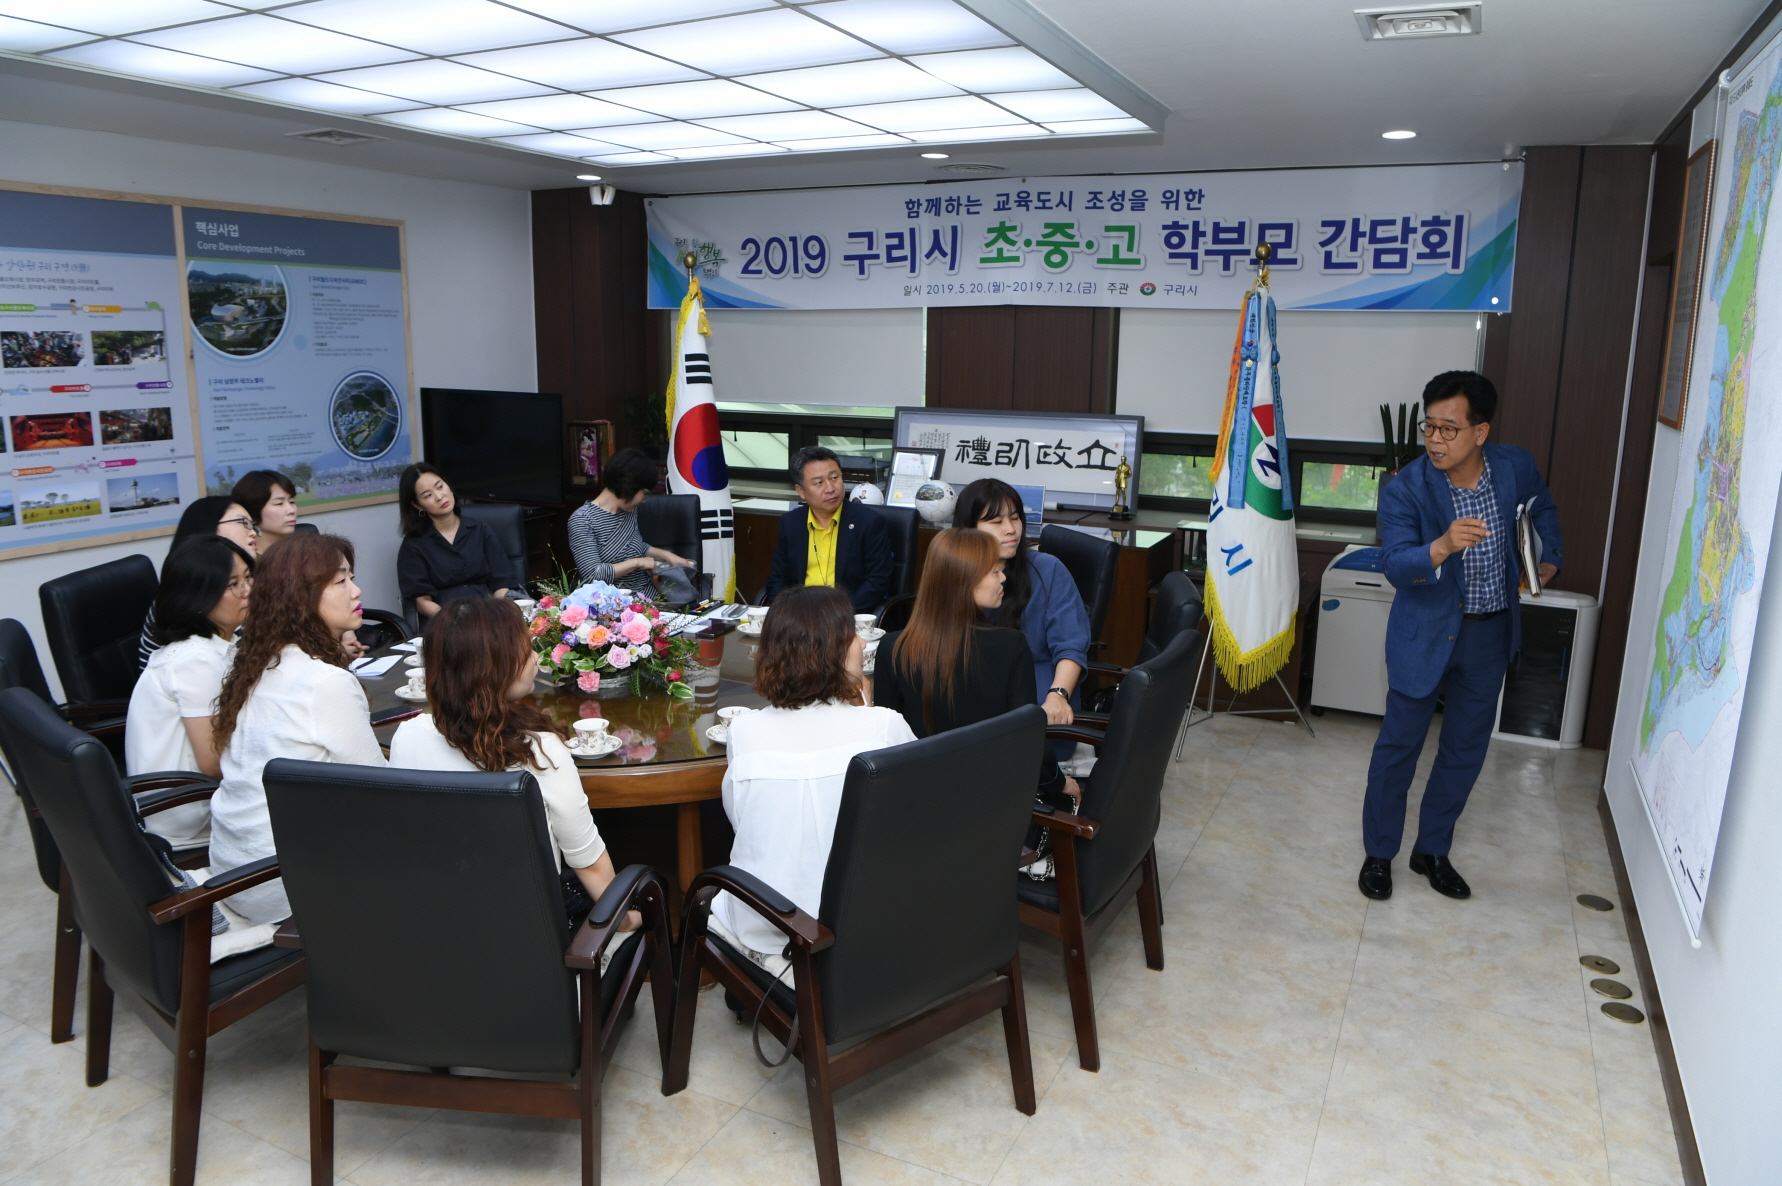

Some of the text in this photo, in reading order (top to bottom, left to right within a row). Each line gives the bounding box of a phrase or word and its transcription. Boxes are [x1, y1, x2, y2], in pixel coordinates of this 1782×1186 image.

[905, 188, 1205, 218] 함께하는 교육도시 조성을 위한
[195, 221, 239, 237] 핵심사업
[197, 241, 305, 256] Core Development Projects
[739, 234, 826, 276] 2019
[842, 225, 961, 276] 구리시
[1162, 219, 1299, 272] 학부모
[1317, 214, 1466, 271] 간담회
[903, 285, 922, 297] 일시
[1106, 282, 1129, 295] 주관
[1162, 282, 1198, 296] 구리시
